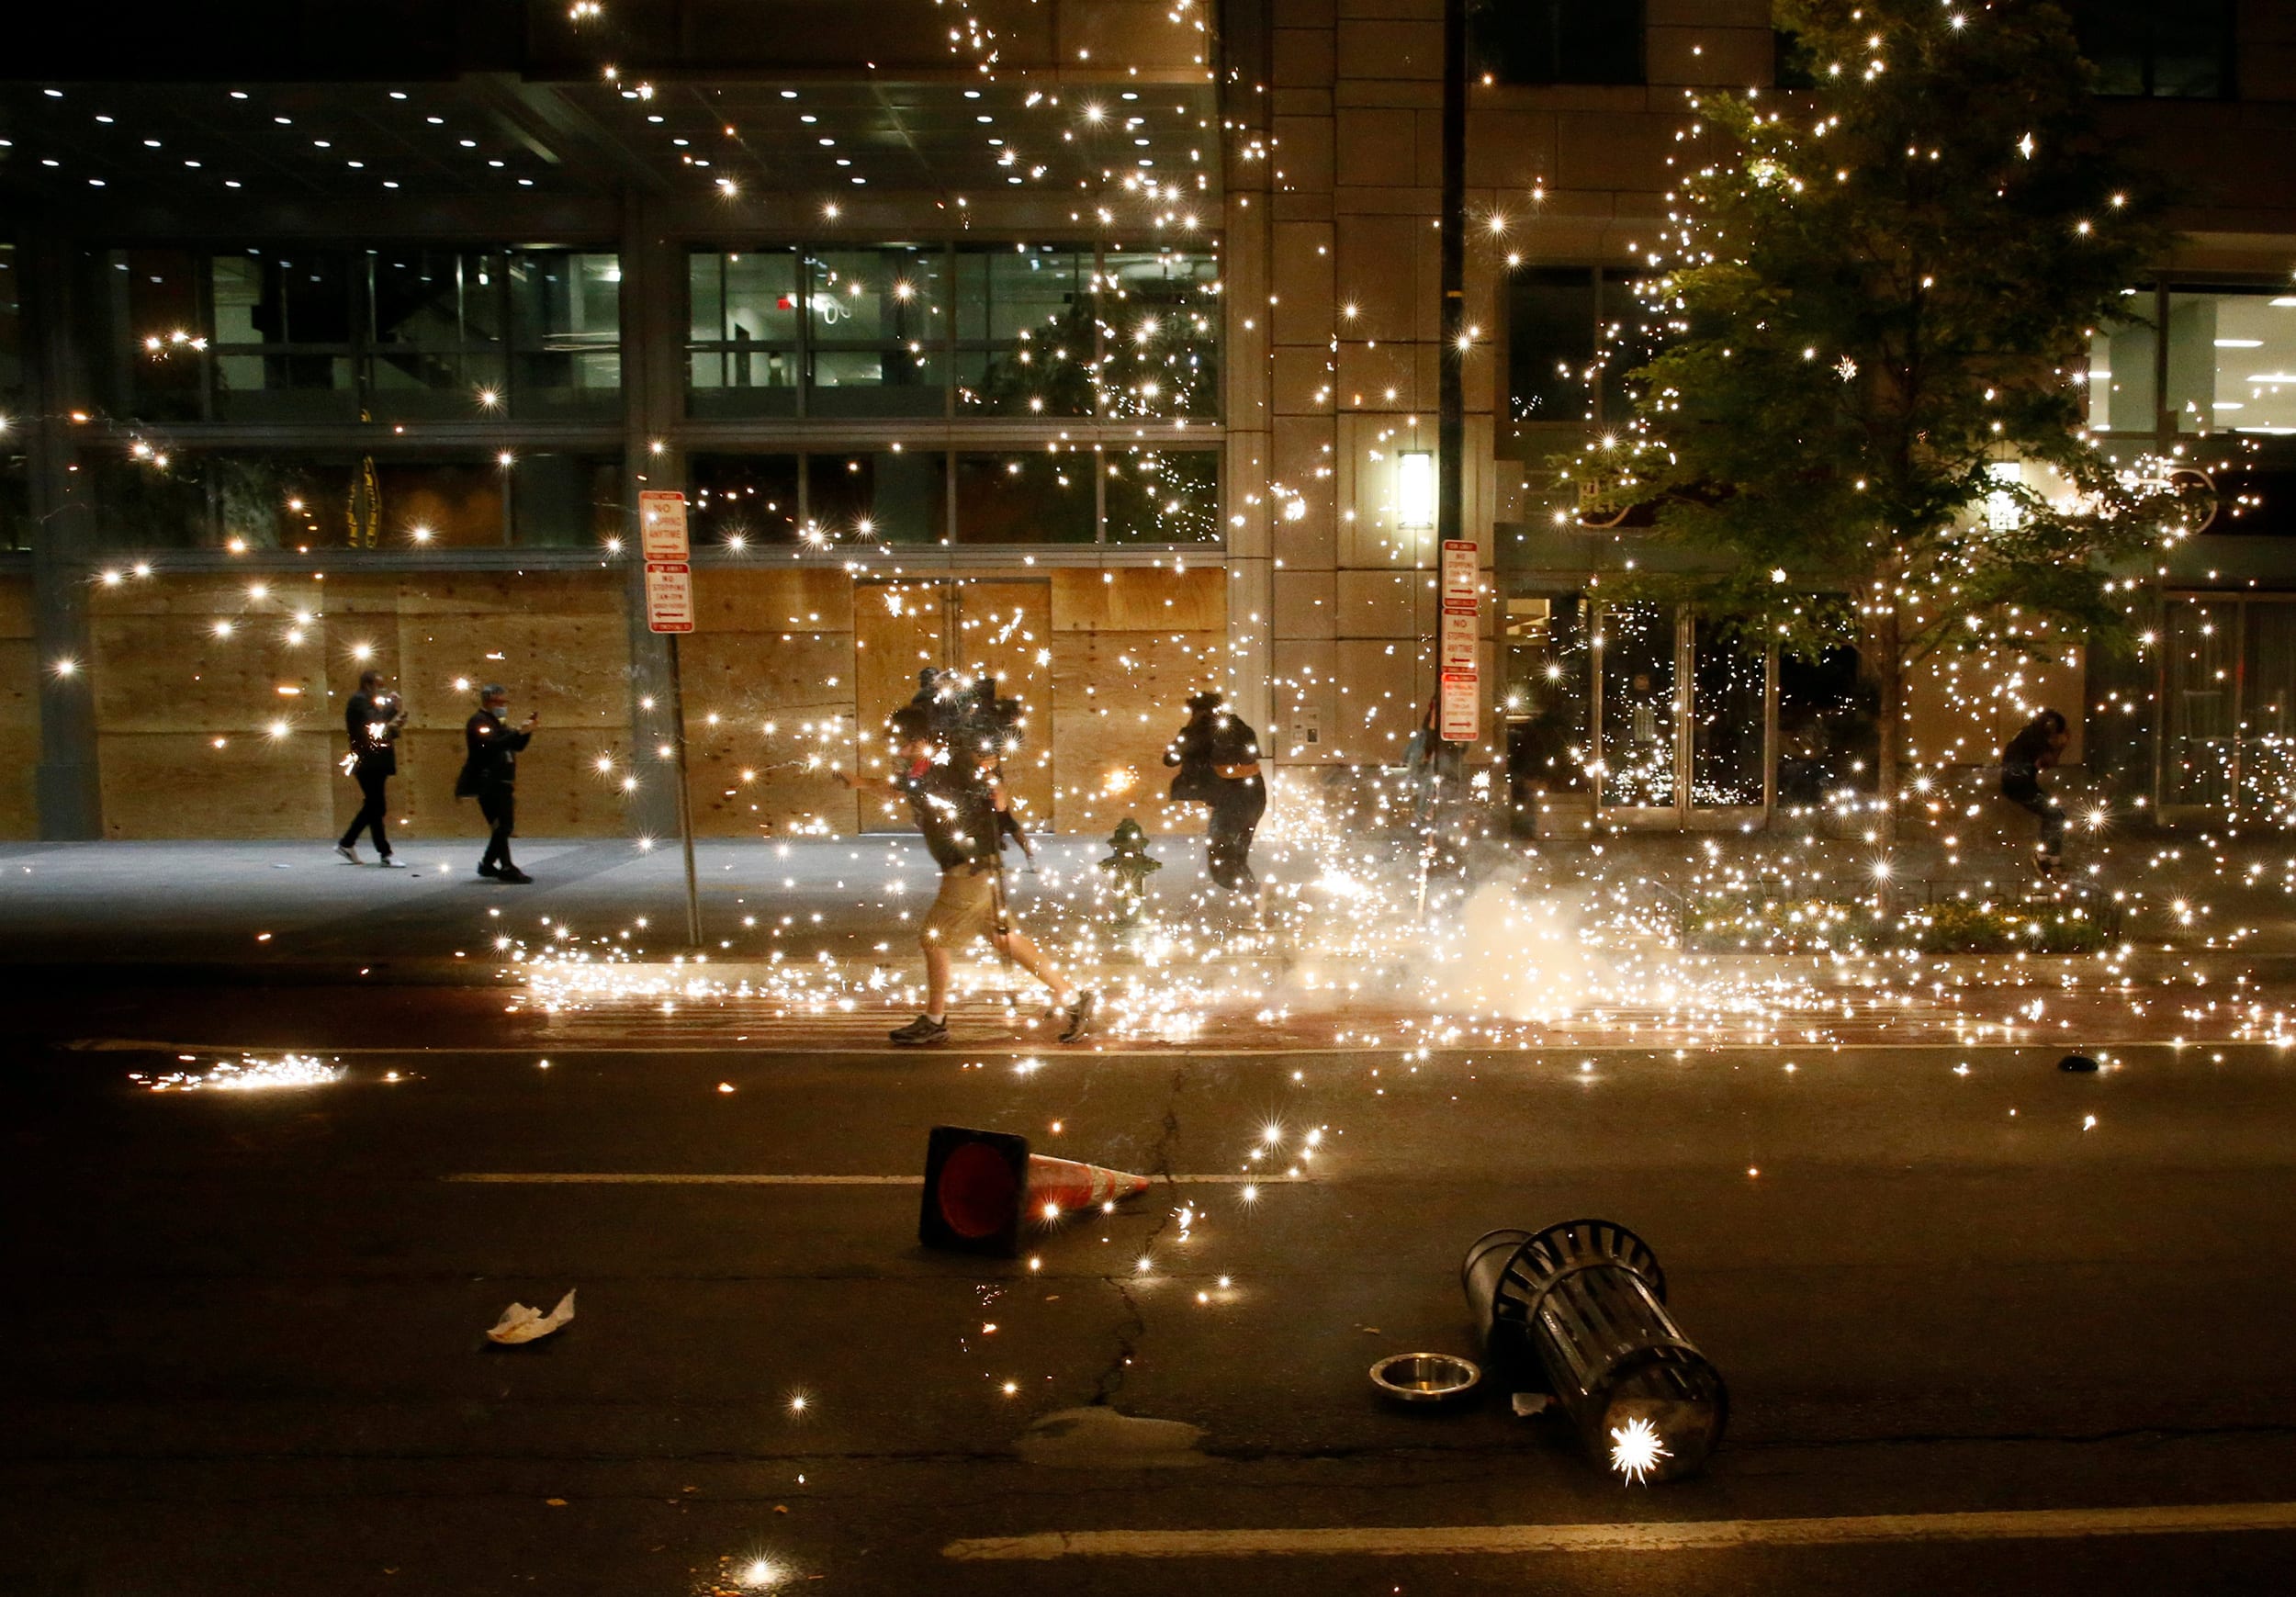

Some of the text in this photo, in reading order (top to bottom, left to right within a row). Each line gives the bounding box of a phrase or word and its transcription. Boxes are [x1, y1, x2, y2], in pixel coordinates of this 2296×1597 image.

[653, 503, 670, 512] NO
[649, 530, 681, 538] ANYTIME
[1454, 619, 1467, 627] NO
[1447, 632, 1474, 641] STOPPING
[1447, 645, 1473, 653] ANYTIME
